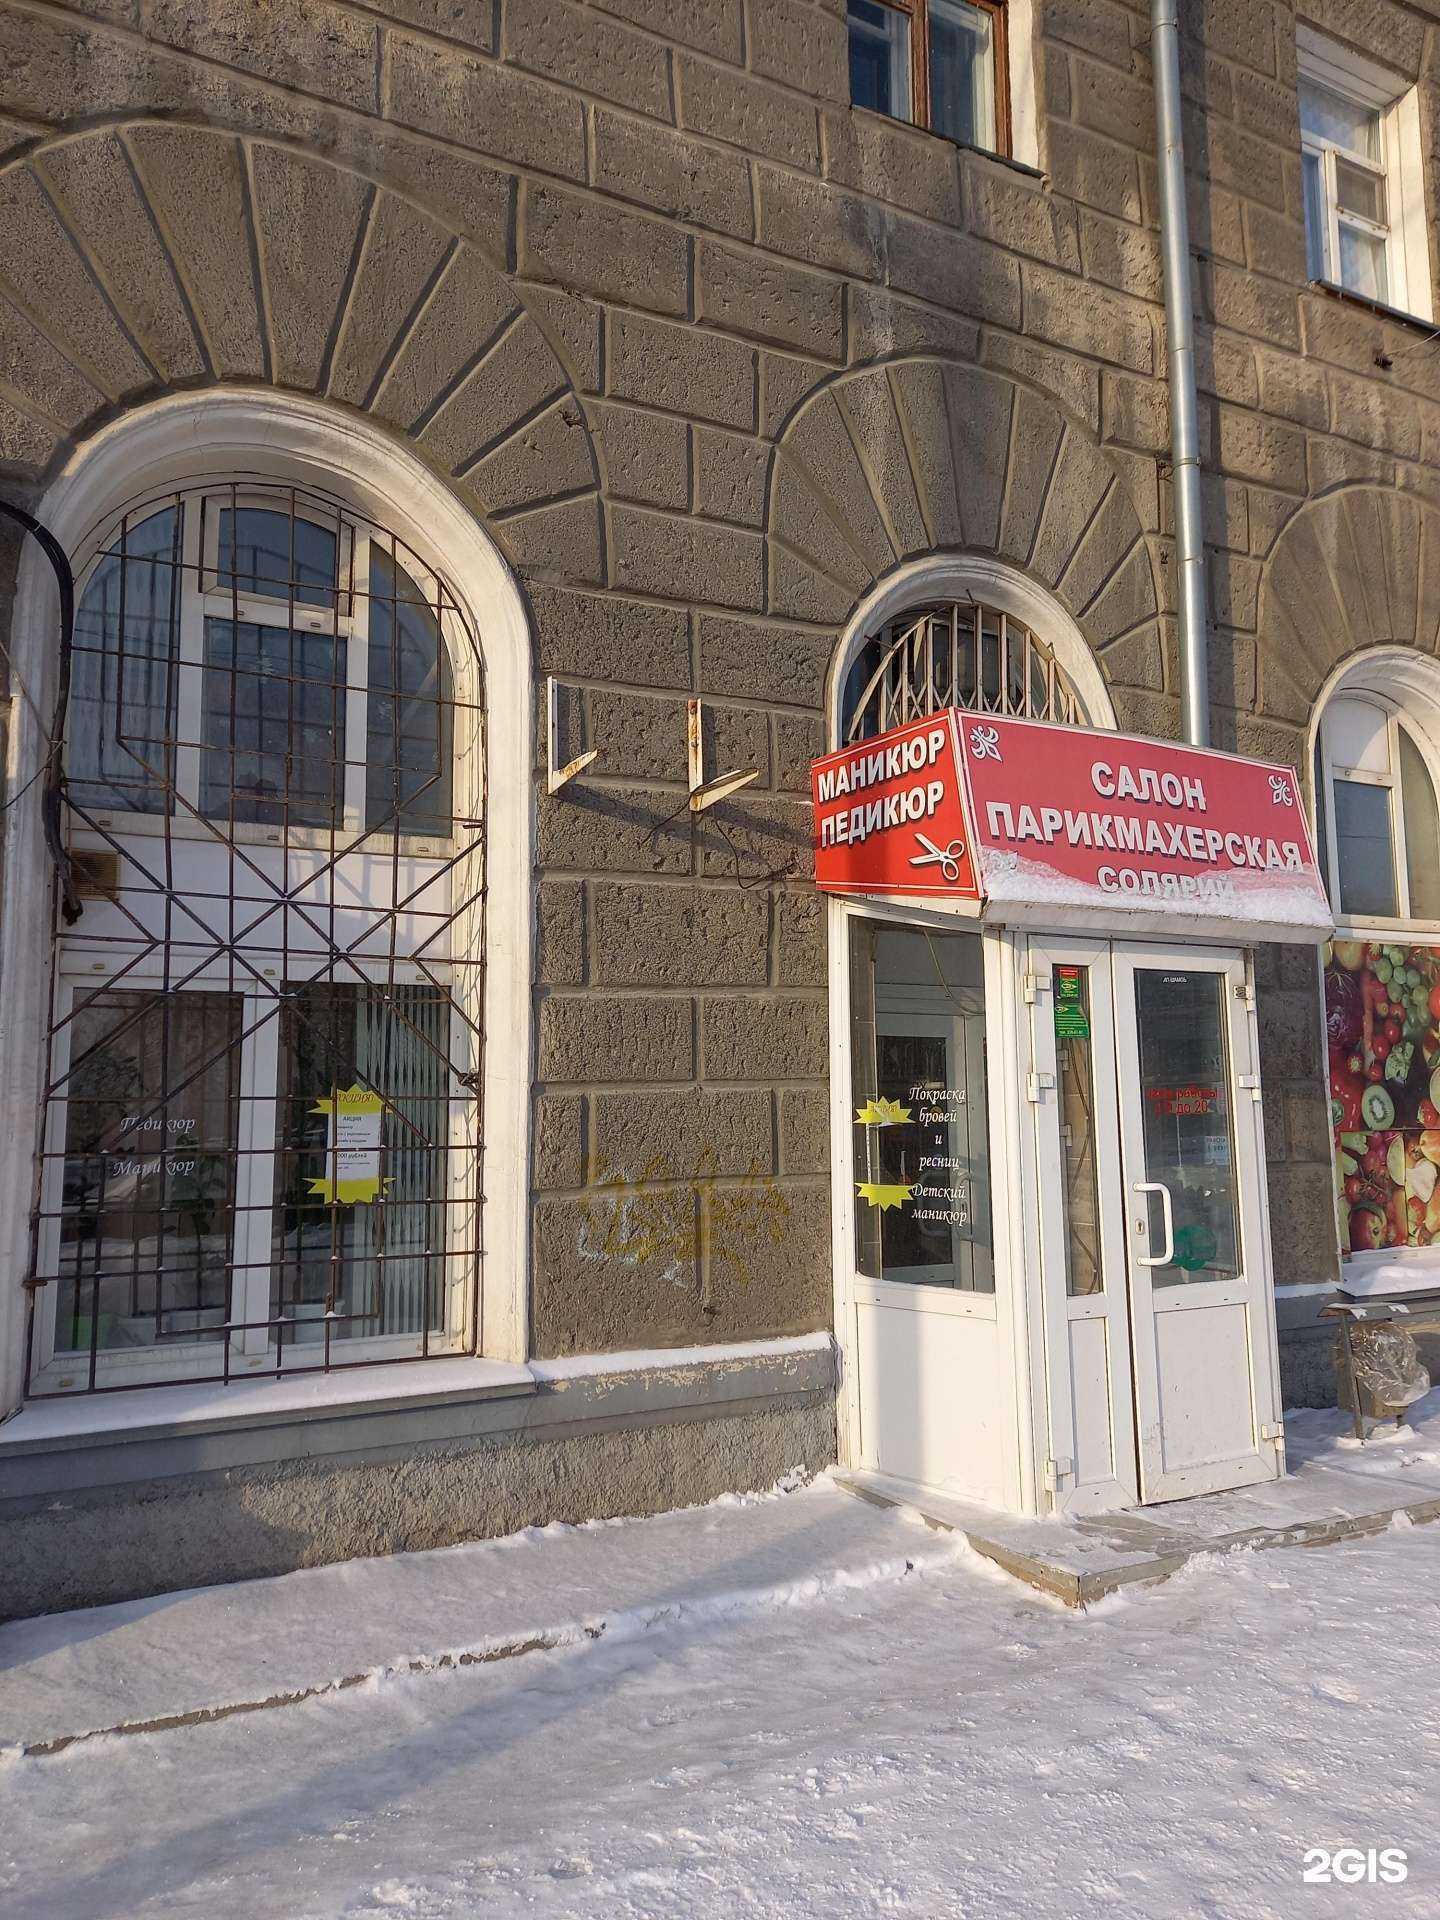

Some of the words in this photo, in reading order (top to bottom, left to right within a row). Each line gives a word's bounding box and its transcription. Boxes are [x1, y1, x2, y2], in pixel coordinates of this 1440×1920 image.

[817, 729, 945, 803] МАНИКЮР
[1091, 761, 1207, 813] САЛОН
[820, 780, 945, 848] ПЕДИКЮР
[985, 800, 1303, 874] ПАРИКМАХЕРСКАЯ
[908, 1086, 966, 1105] Покраска
[919, 1107, 958, 1127] бровей
[935, 1134, 943, 1145] и
[919, 1155, 960, 1171] ресниц
[911, 1183, 966, 1202] Детский
[911, 1208, 967, 1226] маникюр
